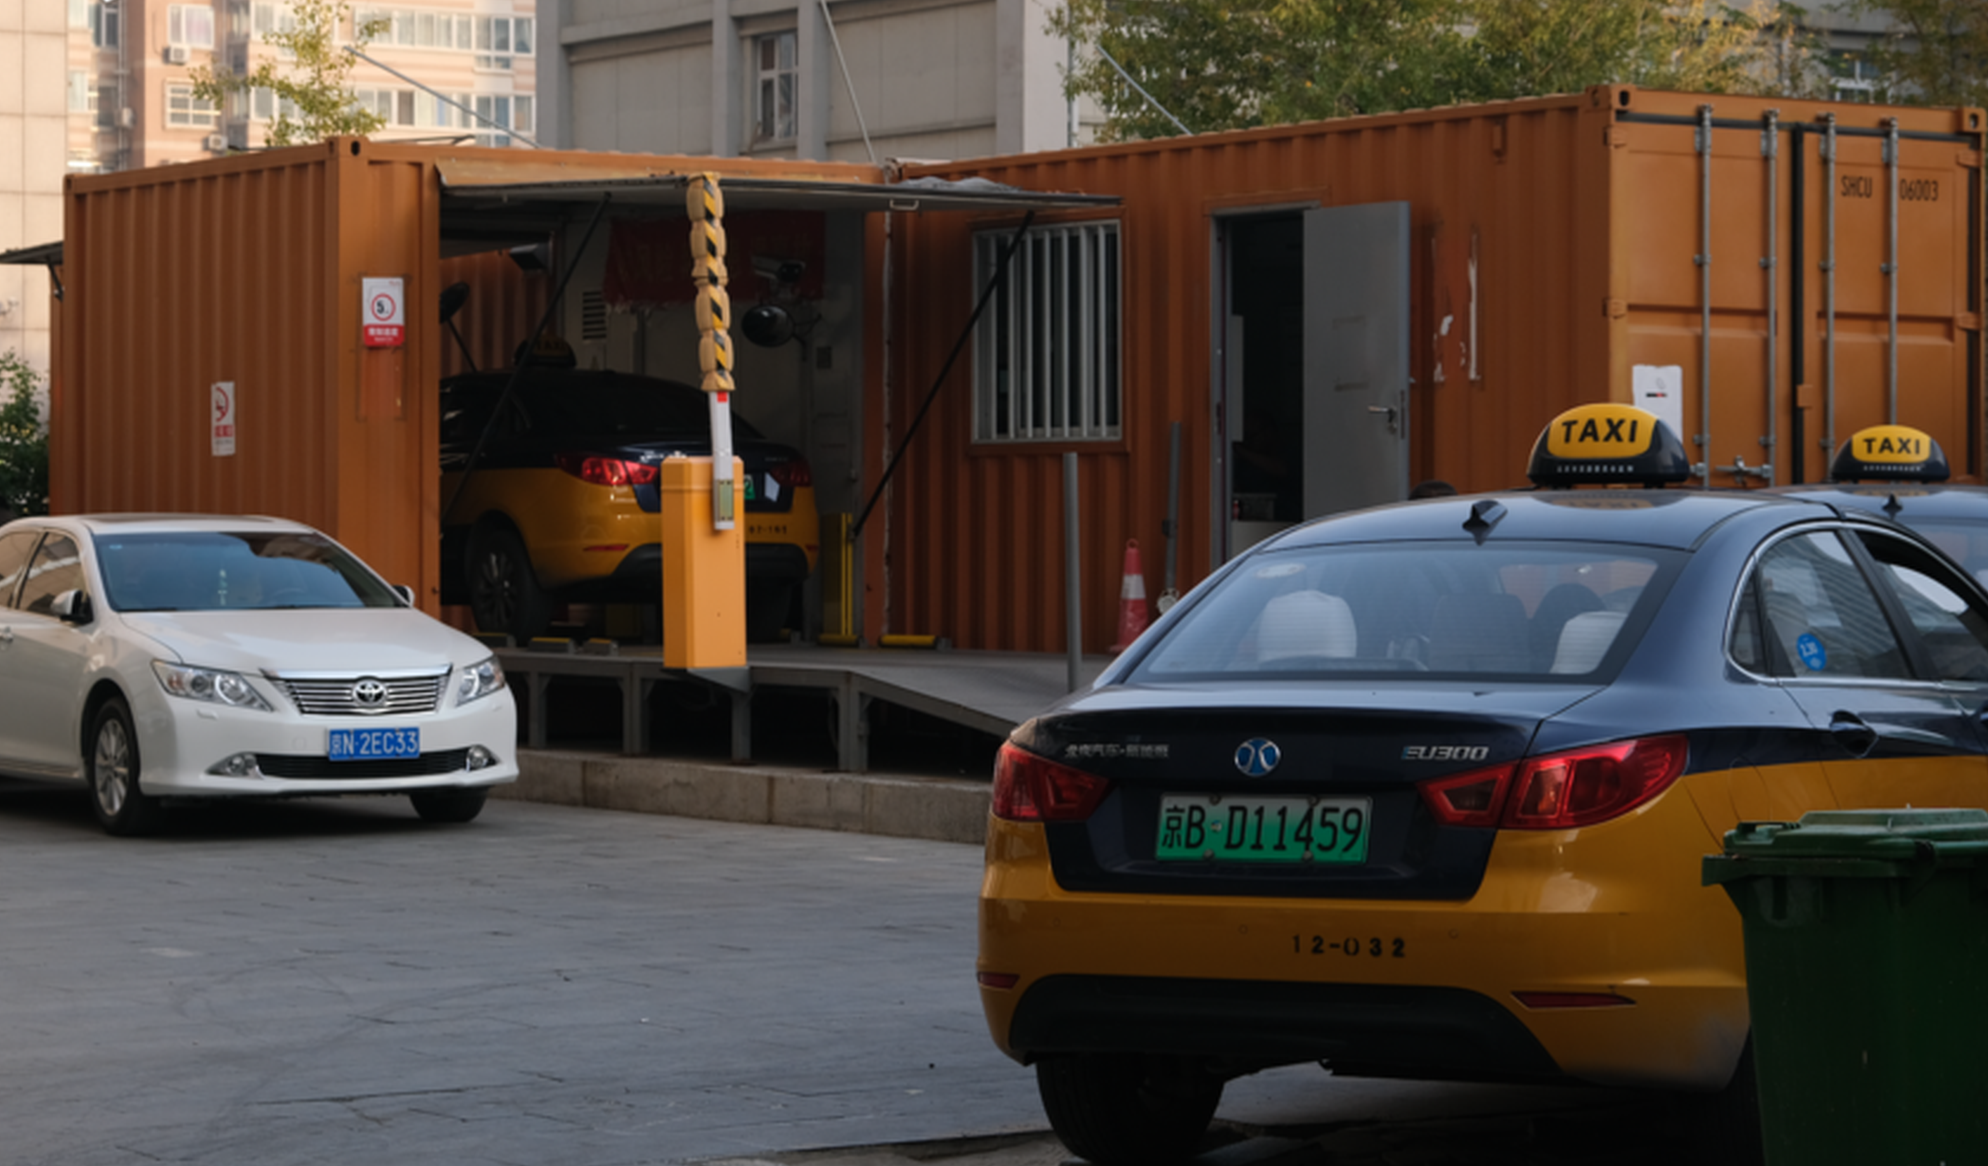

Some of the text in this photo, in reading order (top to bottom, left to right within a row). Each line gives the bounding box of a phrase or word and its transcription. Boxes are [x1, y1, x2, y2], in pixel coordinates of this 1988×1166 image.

[1841, 175, 1939, 201] SHCU 06003
[376, 300, 385, 314] 5
[1562, 418, 1638, 443] TAXI
[1863, 437, 1920, 455] TAXI
[1401, 746, 1490, 761] EU300
